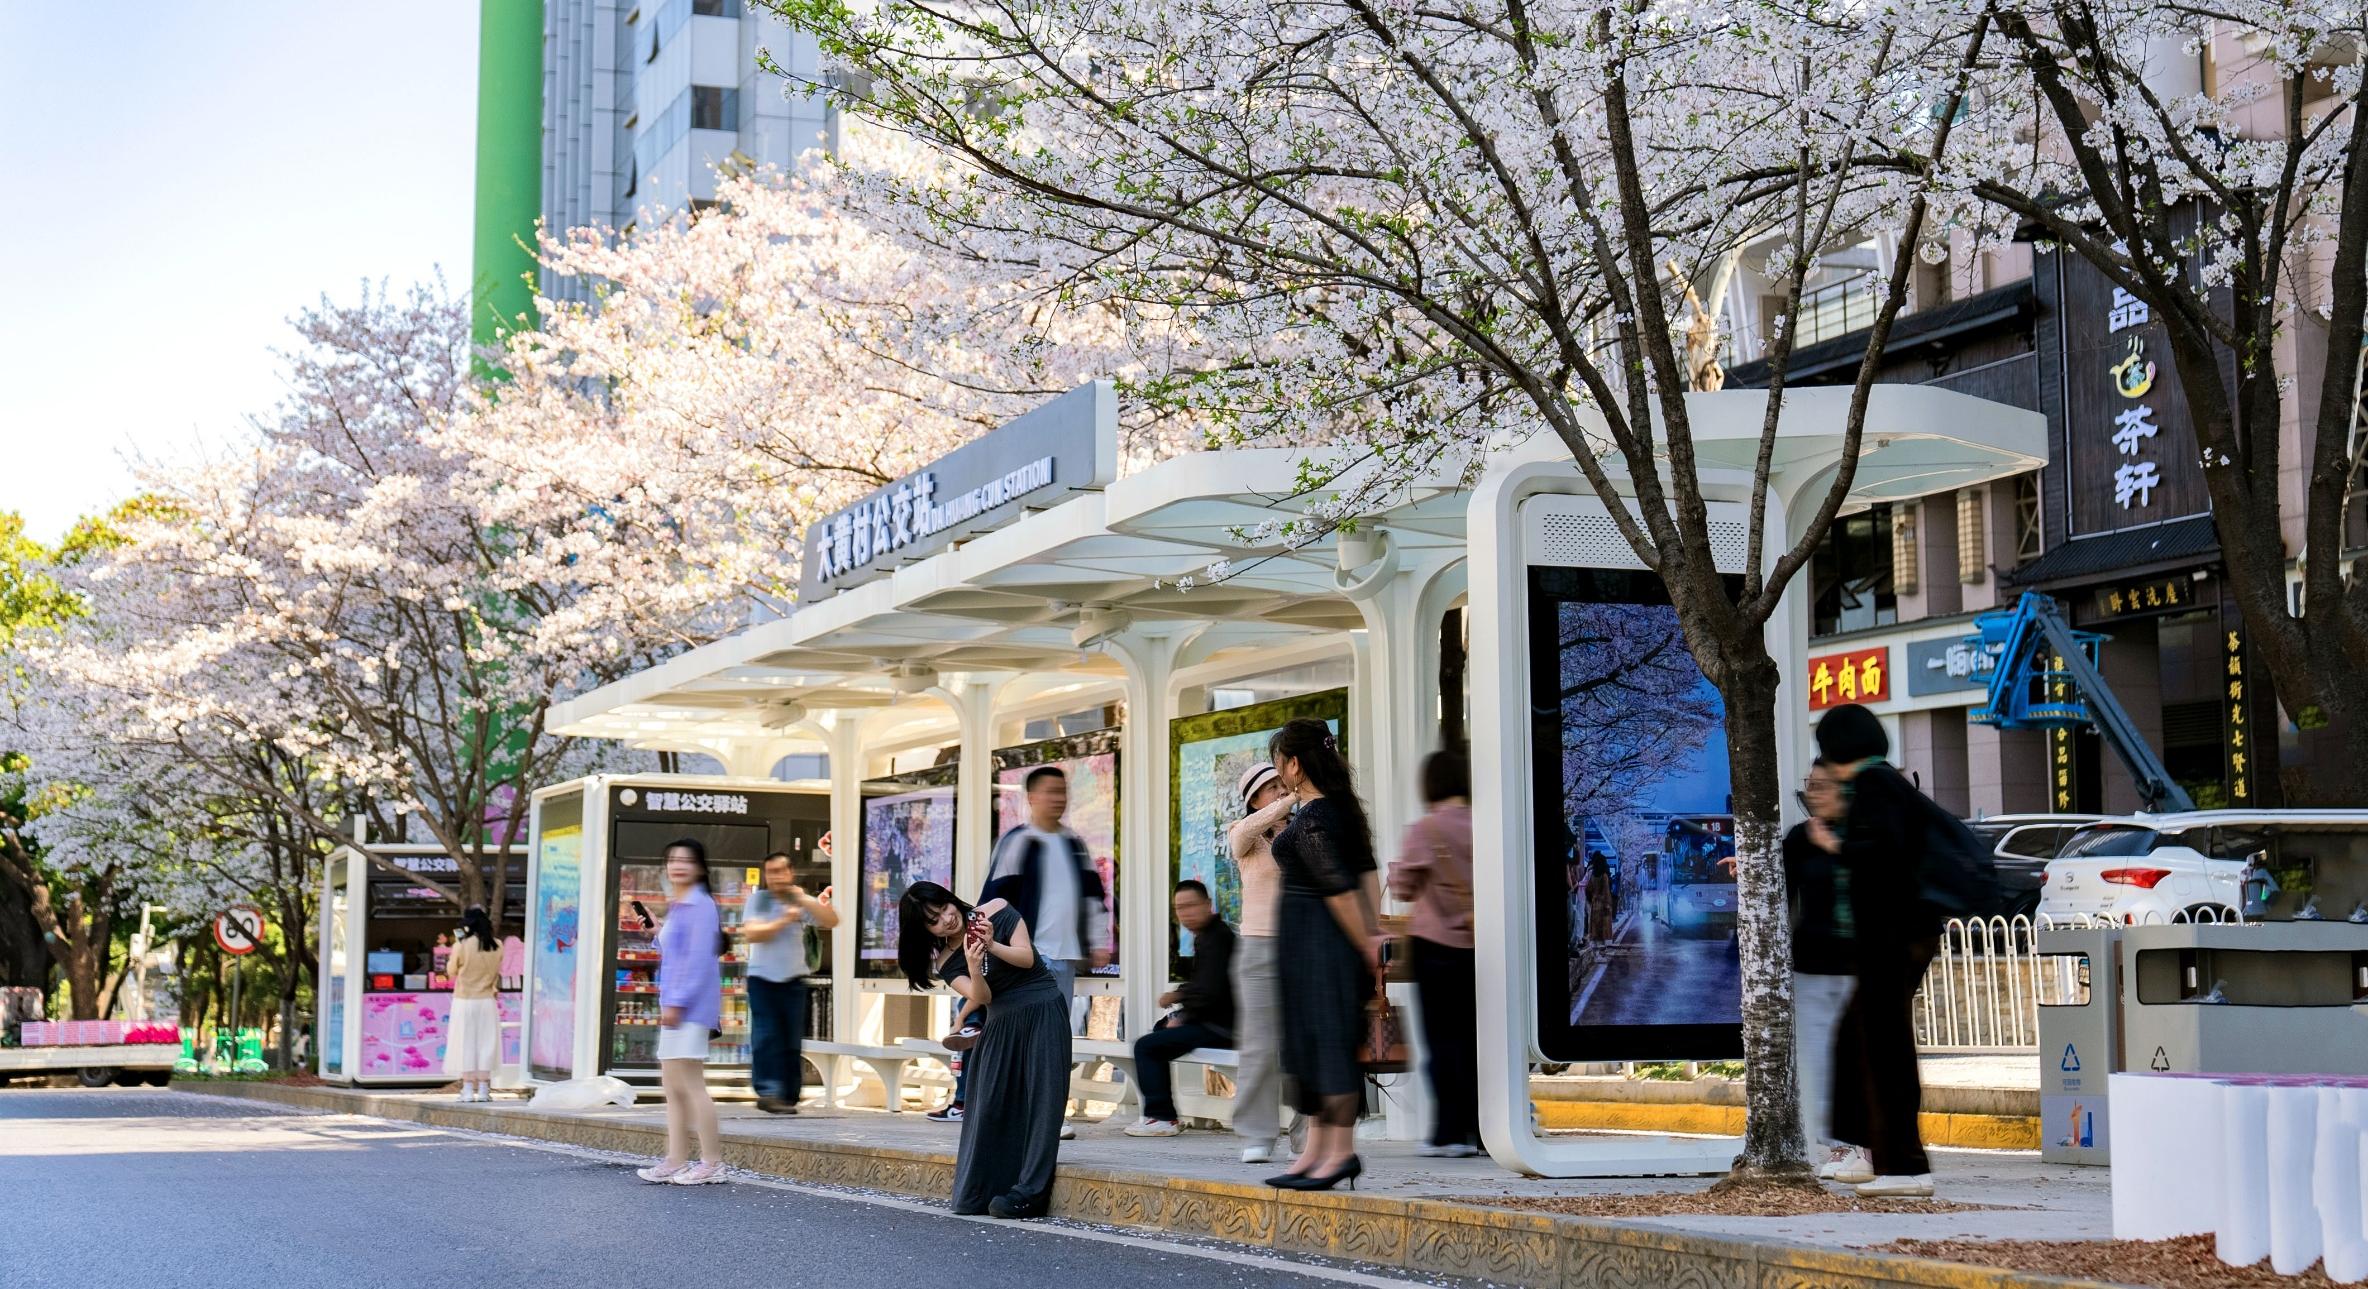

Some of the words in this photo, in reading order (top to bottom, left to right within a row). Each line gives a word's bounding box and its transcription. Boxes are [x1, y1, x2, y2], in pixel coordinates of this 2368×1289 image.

[2109, 238, 2159, 510] 品茶轩
[1004, 456, 1053, 501] STATION
[817, 472, 935, 583] 大黄村公交站
[1808, 655, 1881, 704] 牛肉面
[646, 792, 748, 814] 智慧公交驿站
[1711, 822, 1721, 832] 18
